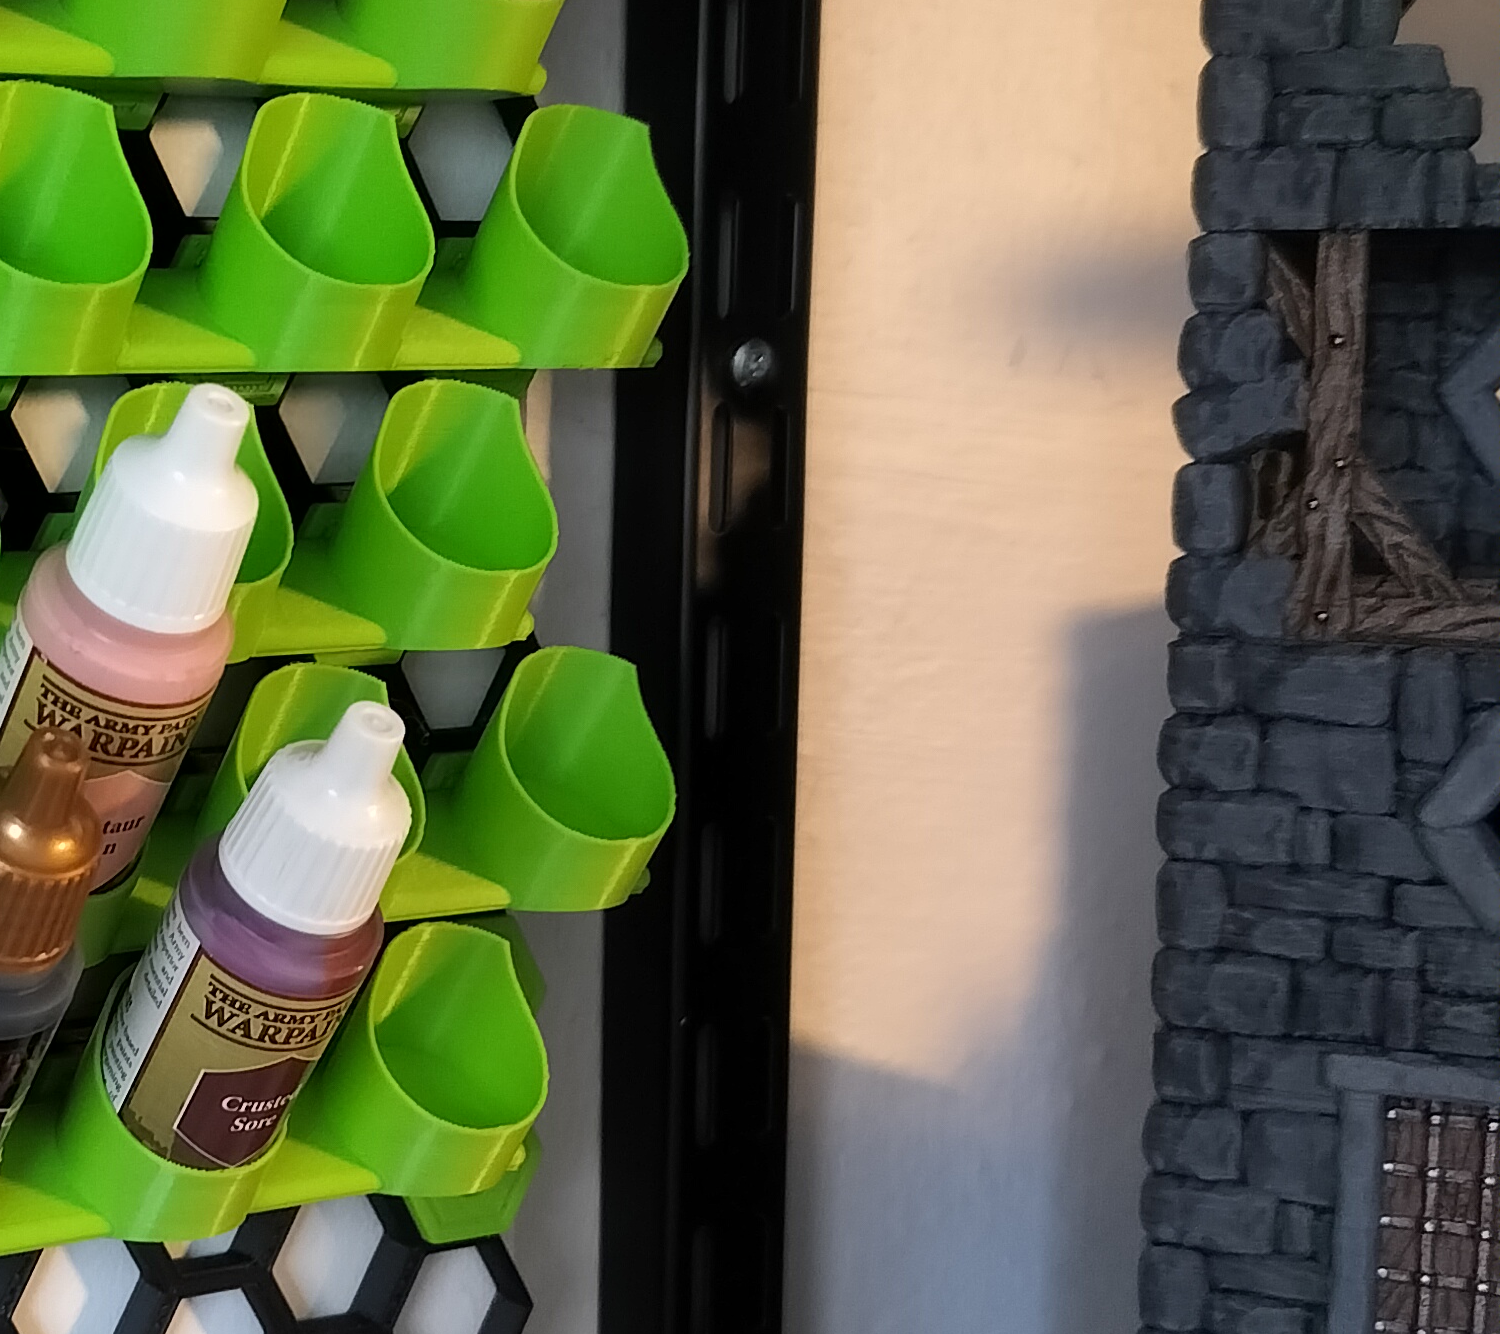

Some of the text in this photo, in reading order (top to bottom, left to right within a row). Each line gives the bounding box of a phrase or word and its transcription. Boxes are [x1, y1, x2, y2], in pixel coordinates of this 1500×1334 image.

[40, 683, 83, 720] THE
[85, 715, 159, 736] ARMY
[101, 815, 146, 835] taur
[208, 981, 252, 1015] THE
[253, 1009, 318, 1025] ARMY
[220, 1091, 297, 1113] Cruste
[229, 1114, 278, 1133] Sore
